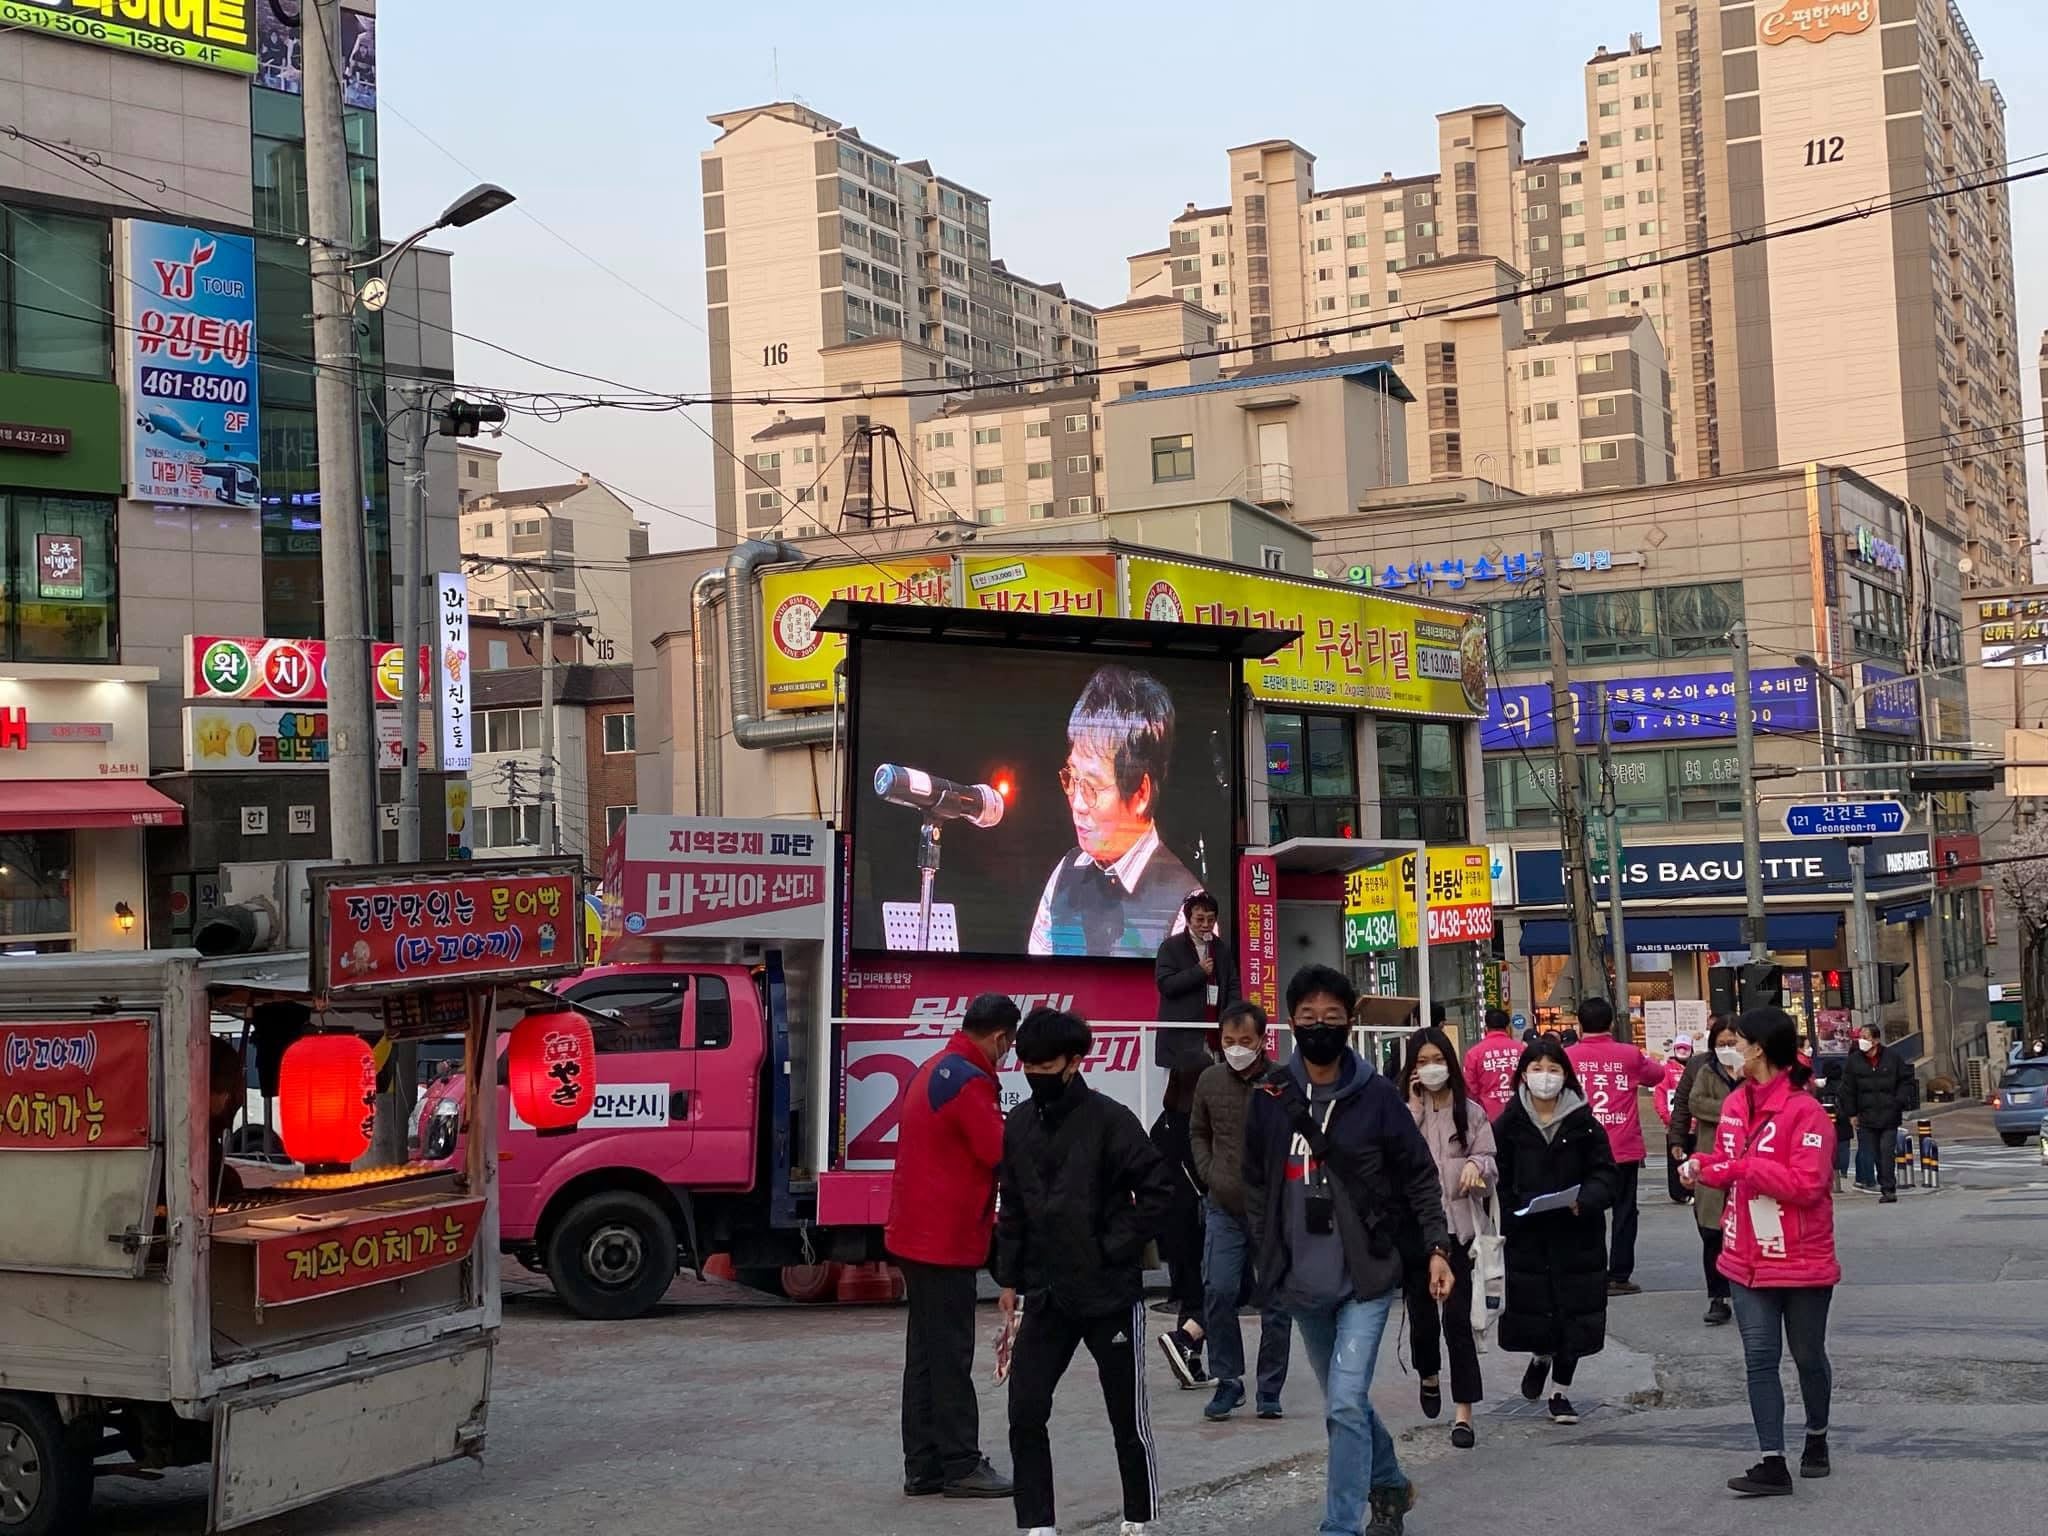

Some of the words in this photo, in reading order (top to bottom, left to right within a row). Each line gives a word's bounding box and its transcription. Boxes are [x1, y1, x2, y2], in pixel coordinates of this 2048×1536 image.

[3, 5, 49, 27] 031)
[55, 16, 186, 57] 506-1586
[197, 47, 221, 63] 4F
[1803, 136, 1845, 167] 112
[153, 260, 195, 299] YJ
[202, 278, 245, 298] TOUR
[137, 311, 252, 366] 유진투어
[763, 343, 788, 367] 116
[143, 371, 247, 402] 461-8500
[15, 428, 65, 444] 437-2131
[224, 412, 249, 433] 2F
[152, 461, 203, 485] 대절가능
[1572, 549, 1611, 570] 의원
[597, 639, 614, 660] 115
[1315, 618, 1412, 681] 무한리필
[1667, 685, 1699, 700] 소아
[1776, 678, 1808, 693] 비만
[449, 684, 464, 748] 친구들
[1792, 816, 1809, 826] 121
[1822, 806, 1868, 821] 건건로
[1882, 812, 1899, 823] 117
[1815, 823, 1877, 833] Geongeon-ro
[669, 830, 764, 856] 지역경제
[770, 833, 814, 857] 파탄
[646, 872, 766, 921] 바꿔야
[772, 873, 814, 904] 산다!
[1433, 869, 1463, 900] 부동산
[347, 889, 474, 932] 정말맛있는
[490, 885, 561, 921] 문어빵
[1263, 904, 1274, 959] 국회의원
[1440, 907, 1492, 938] 438-3333
[1637, 944, 1662, 952] PARIS
[1663, 943, 1710, 951] BAGUETTE
[864, 972, 912, 984] 미래통합당
[1250, 958, 1260, 985] 국회
[1263, 965, 1276, 1017] 기득권
[1578, 1062, 1598, 1072] 정권
[1603, 1062, 1622, 1072] 심판
[1499, 1073, 1510, 1089] 2
[1592, 1091, 1609, 1113] 2
[1757, 1122, 1777, 1152] 2
[286, 1215, 464, 1280] 계좌이체가능
